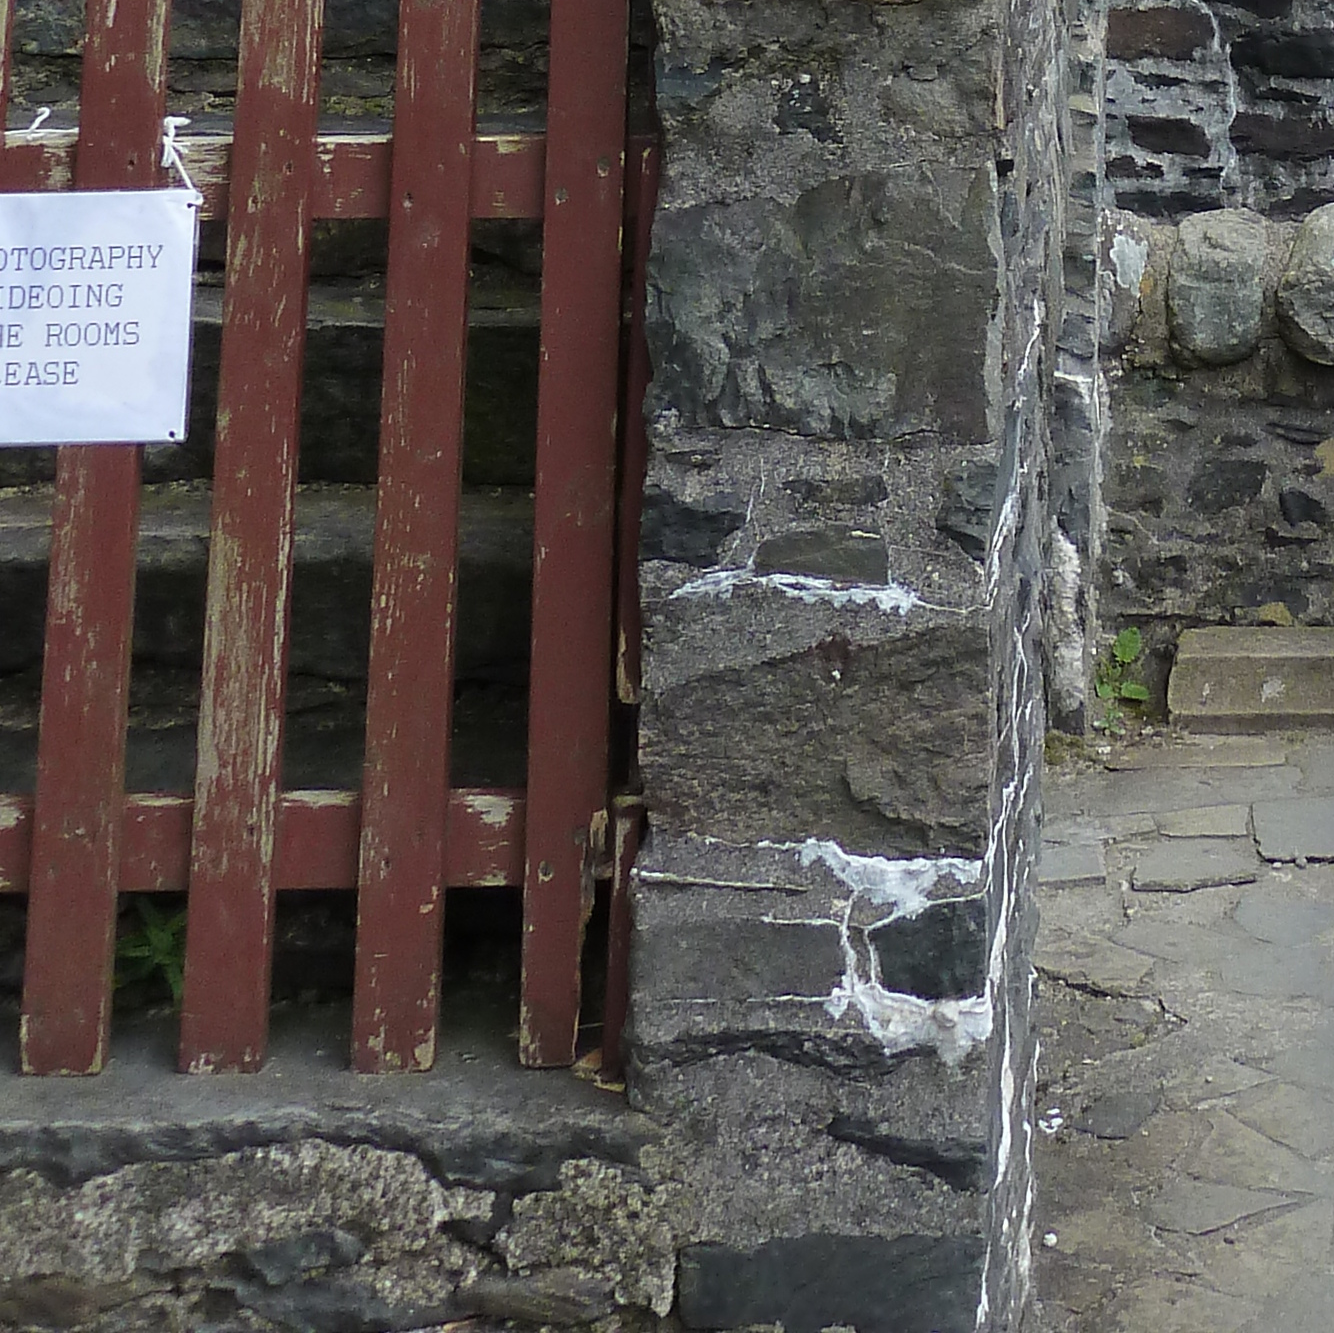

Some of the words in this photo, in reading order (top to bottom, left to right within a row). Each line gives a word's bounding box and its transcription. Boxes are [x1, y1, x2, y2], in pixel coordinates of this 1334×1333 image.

[0, 284, 123, 309] DEOING
[0, 323, 24, 348] E
[45, 322, 140, 347] ROOMS
[0, 361, 80, 386] EASE
